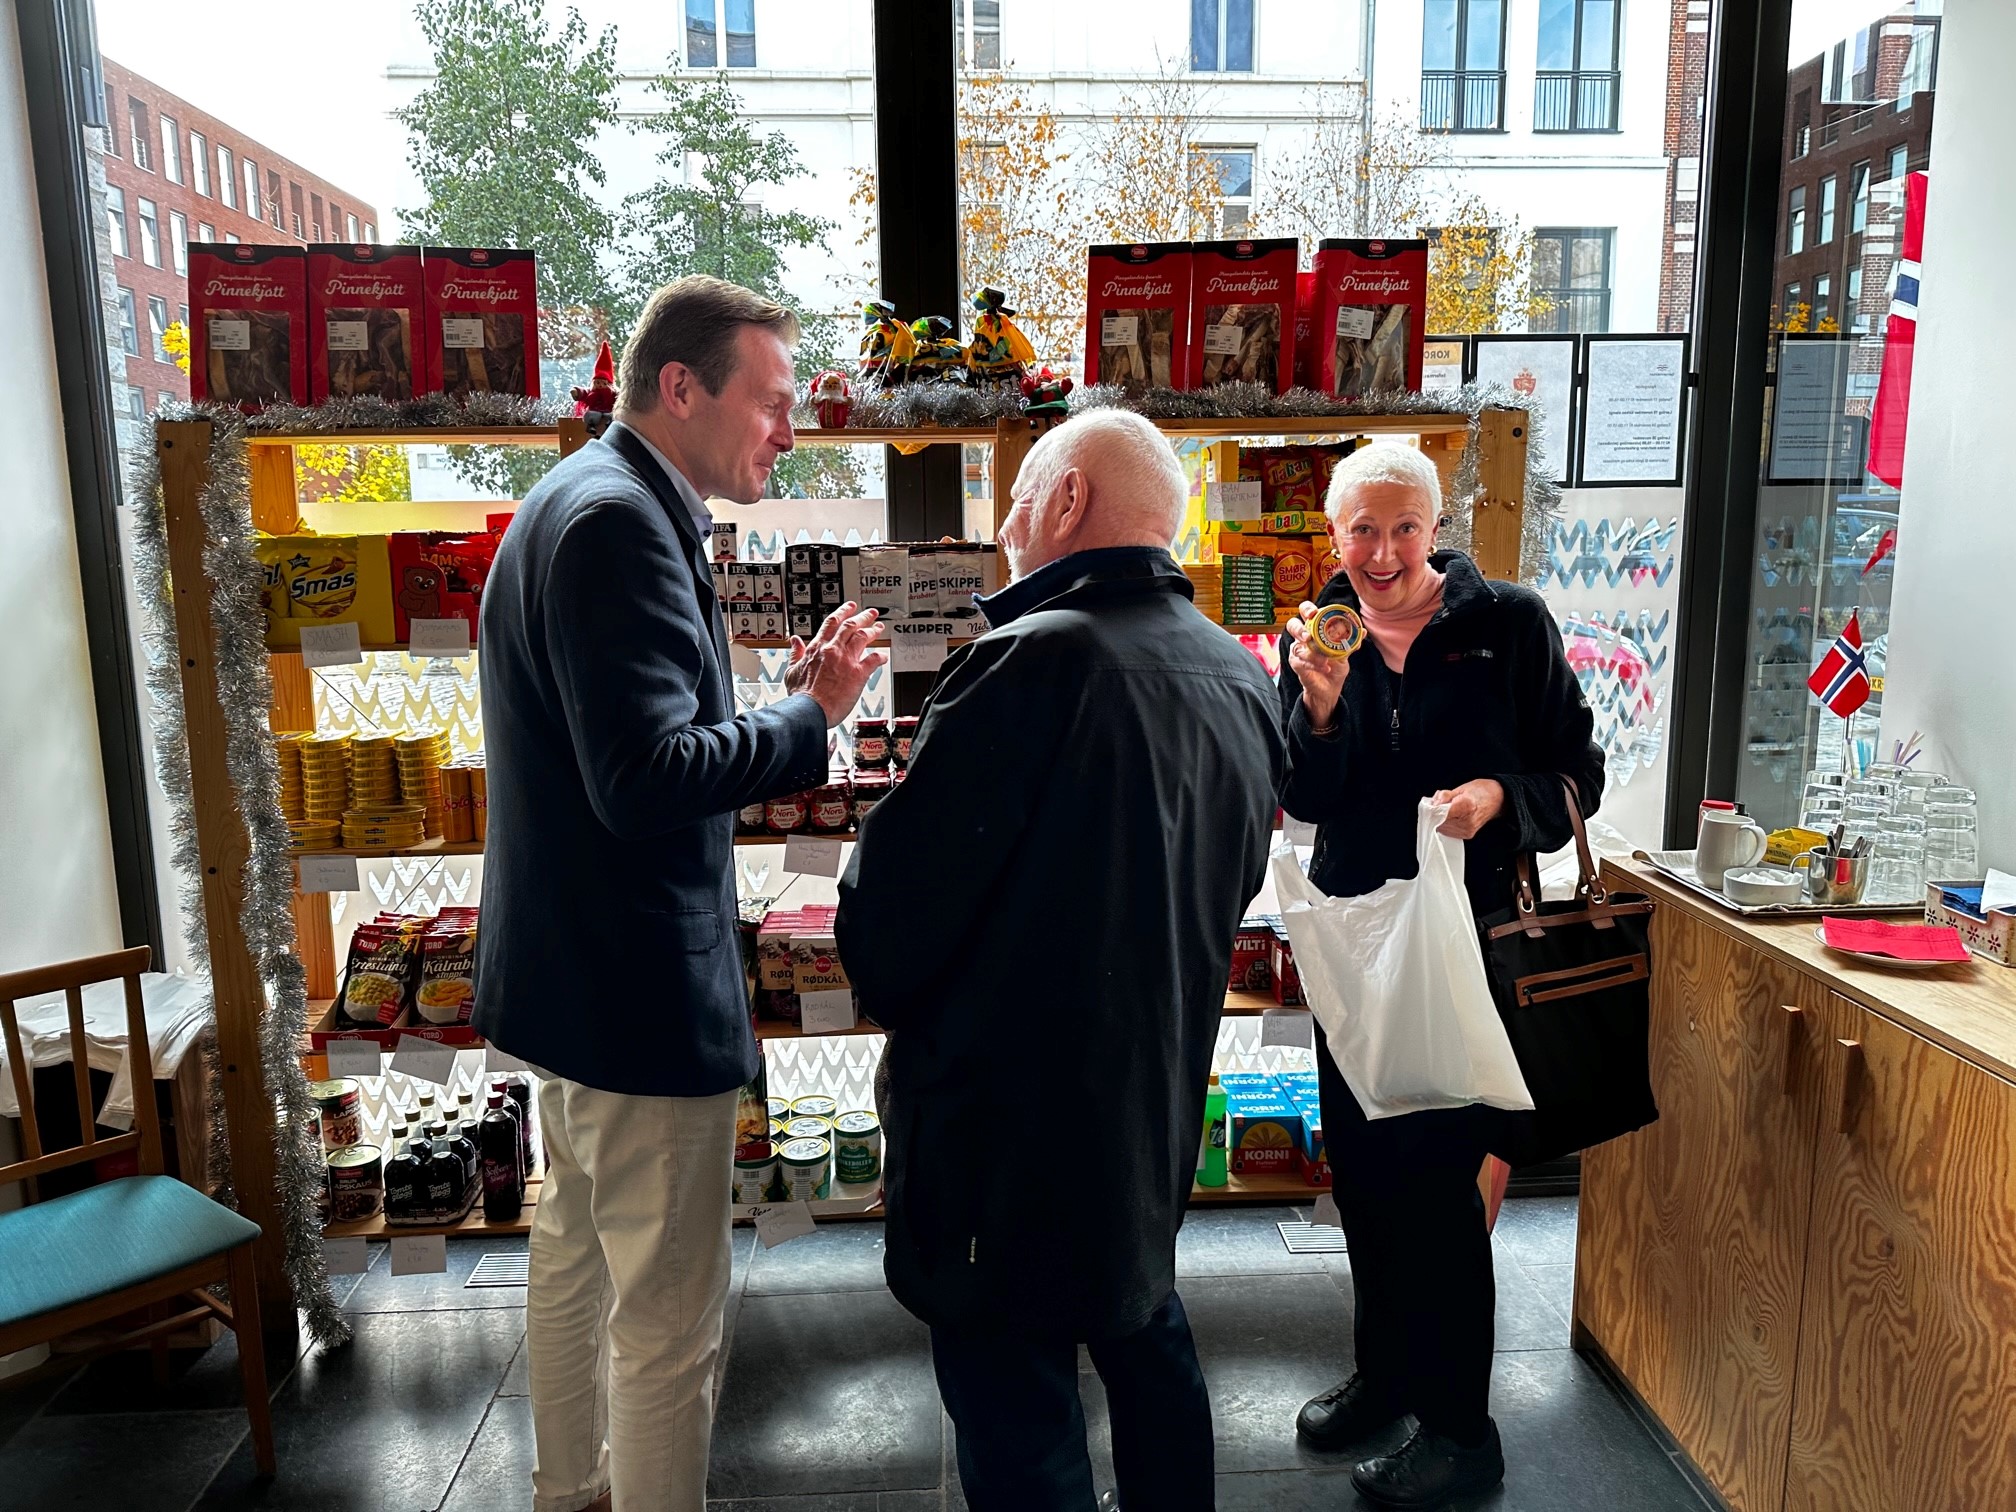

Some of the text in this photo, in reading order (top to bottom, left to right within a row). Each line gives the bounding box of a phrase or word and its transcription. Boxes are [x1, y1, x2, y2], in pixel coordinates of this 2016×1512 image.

[1271, 457, 1312, 483] Laban
[1263, 513, 1299, 532] Laban
[715, 524, 732, 532] IFA
[732, 565, 748, 574] IFA
[758, 565, 775, 574] IFA
[1279, 564, 1306, 575] SMØR
[1280, 572, 1306, 582] BUKK
[291, 572, 356, 599] Smas
[939, 577, 982, 588] SKIPPE
[736, 603, 752, 612] IFA
[761, 603, 778, 612] IFA
[893, 623, 954, 635] SKIPPER
[862, 740, 882, 749] Nora
[444, 795, 470, 812] Solo
[774, 807, 796, 817] Nora
[821, 805, 843, 815] Nora
[359, 939, 378, 950] TORO
[424, 941, 442, 950] TORO
[802, 973, 844, 984] RØDKÅL
[422, 1031, 440, 1039] TORO
[1245, 1150, 1289, 1161] KORNI
[428, 1182, 451, 1192] Tomte
